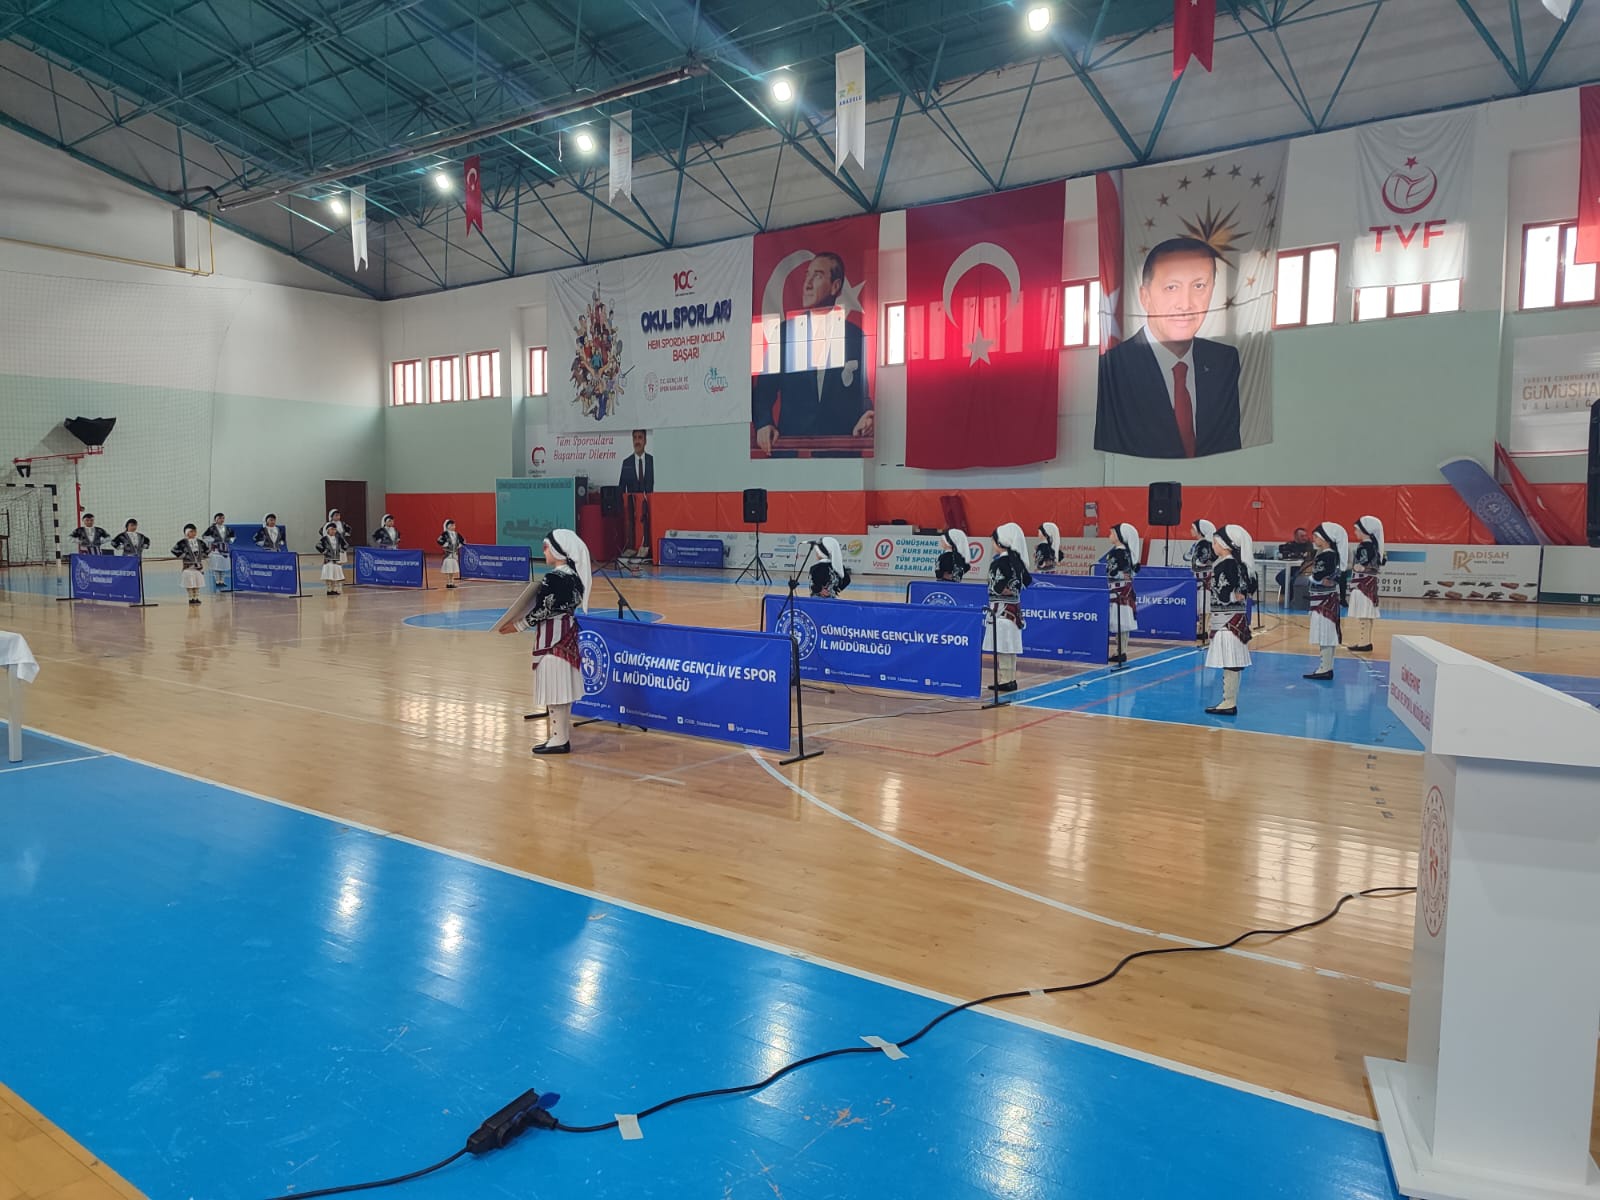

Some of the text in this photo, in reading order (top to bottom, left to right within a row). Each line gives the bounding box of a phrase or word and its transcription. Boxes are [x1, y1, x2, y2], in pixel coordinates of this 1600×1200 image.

[1369, 219, 1447, 252] TVF
[641, 298, 732, 334] OKUL SPORLARI
[647, 330, 726, 350] HEM SPORDA HEM OKULDA
[672, 347, 700, 363] BAŞARI
[1523, 382, 1600, 401] GÜMÜŞHA
[896, 539, 939, 547] GÜMÜŞHANE
[902, 547, 921, 555] KURS
[896, 555, 911, 563] TÜM
[1152, 597, 1163, 605] VE
[1163, 597, 1187, 606] SPOR
[1058, 610, 1071, 620] VE
[1072, 611, 1098, 622] SPOR
[820, 624, 969, 647] GÜMÜŞHANE GENÇLİK VE SPOR
[820, 639, 892, 656] İL MÜDÜRLÜĞÜ
[614, 650, 777, 683] GÜMÜŞHANE GENÇLİK VE SPOR
[612, 667, 691, 693] İL MÜDÜRLÜĞÜ
